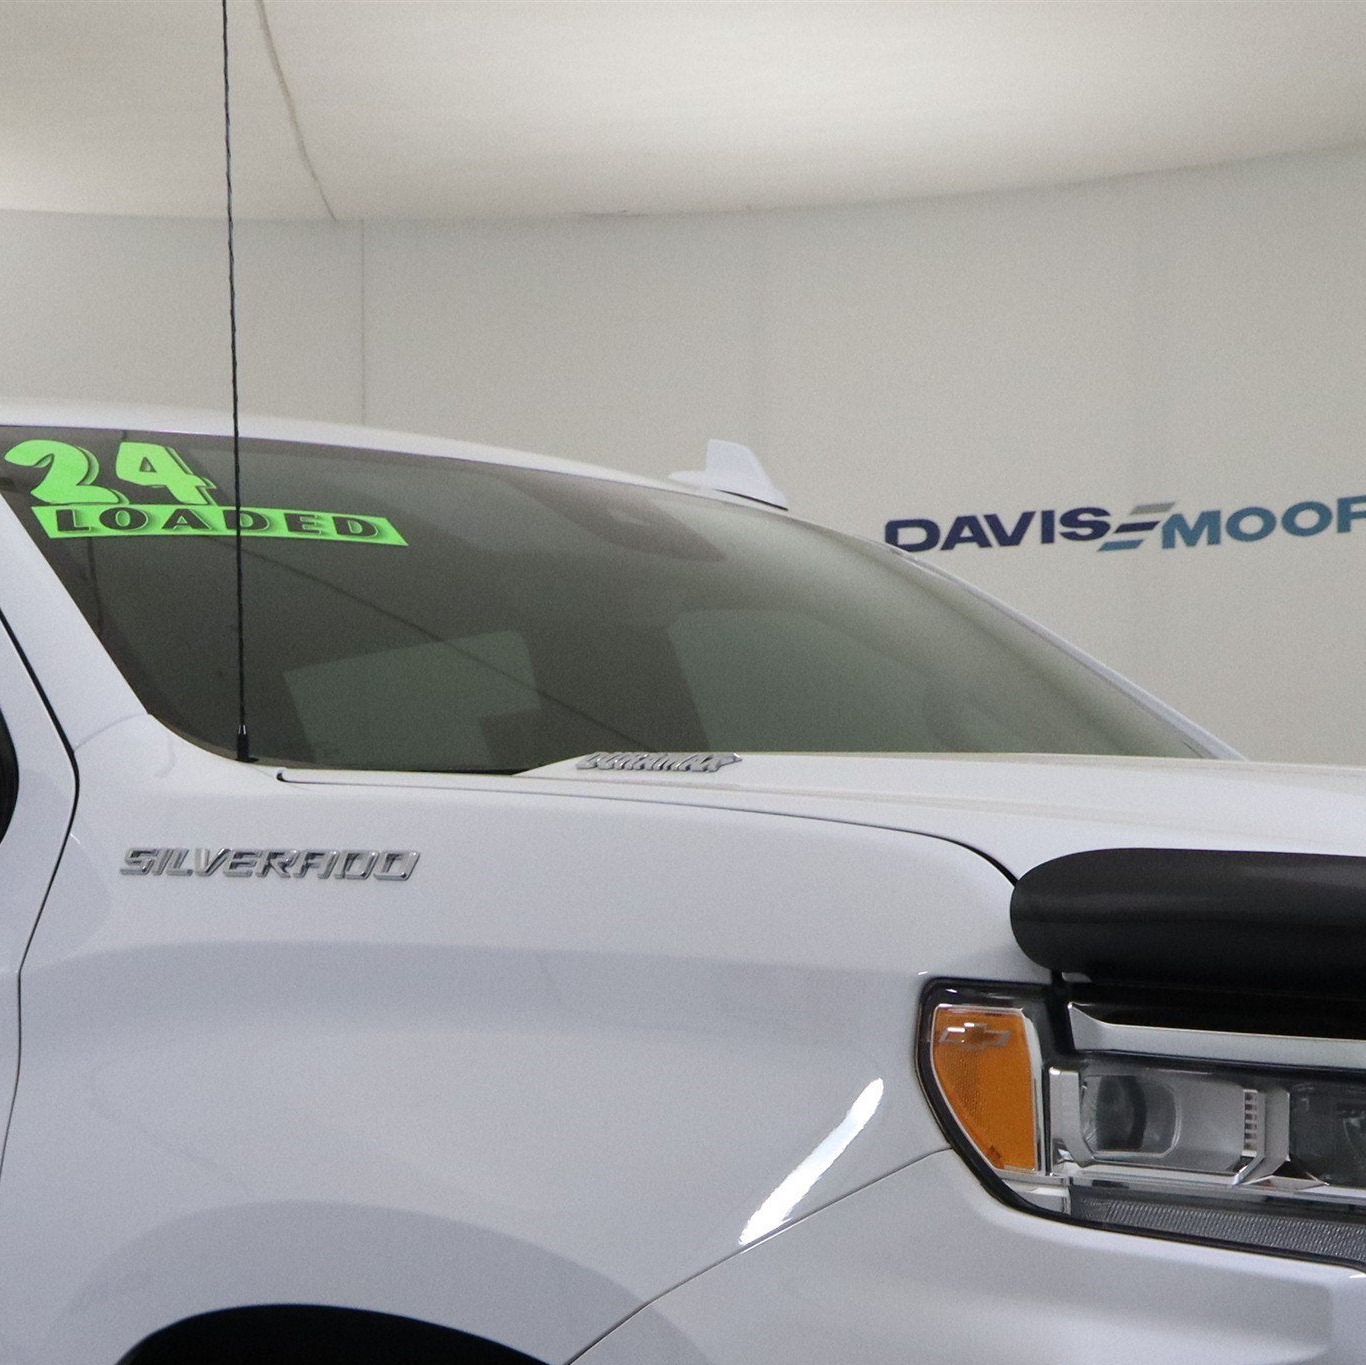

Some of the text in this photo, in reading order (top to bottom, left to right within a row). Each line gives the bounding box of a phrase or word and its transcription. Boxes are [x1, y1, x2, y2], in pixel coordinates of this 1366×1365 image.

[4, 439, 218, 506] 24
[55, 507, 379, 539] LOADED
[885, 507, 1111, 552] DAVIS
[120, 848, 422, 881] SILVERADO
